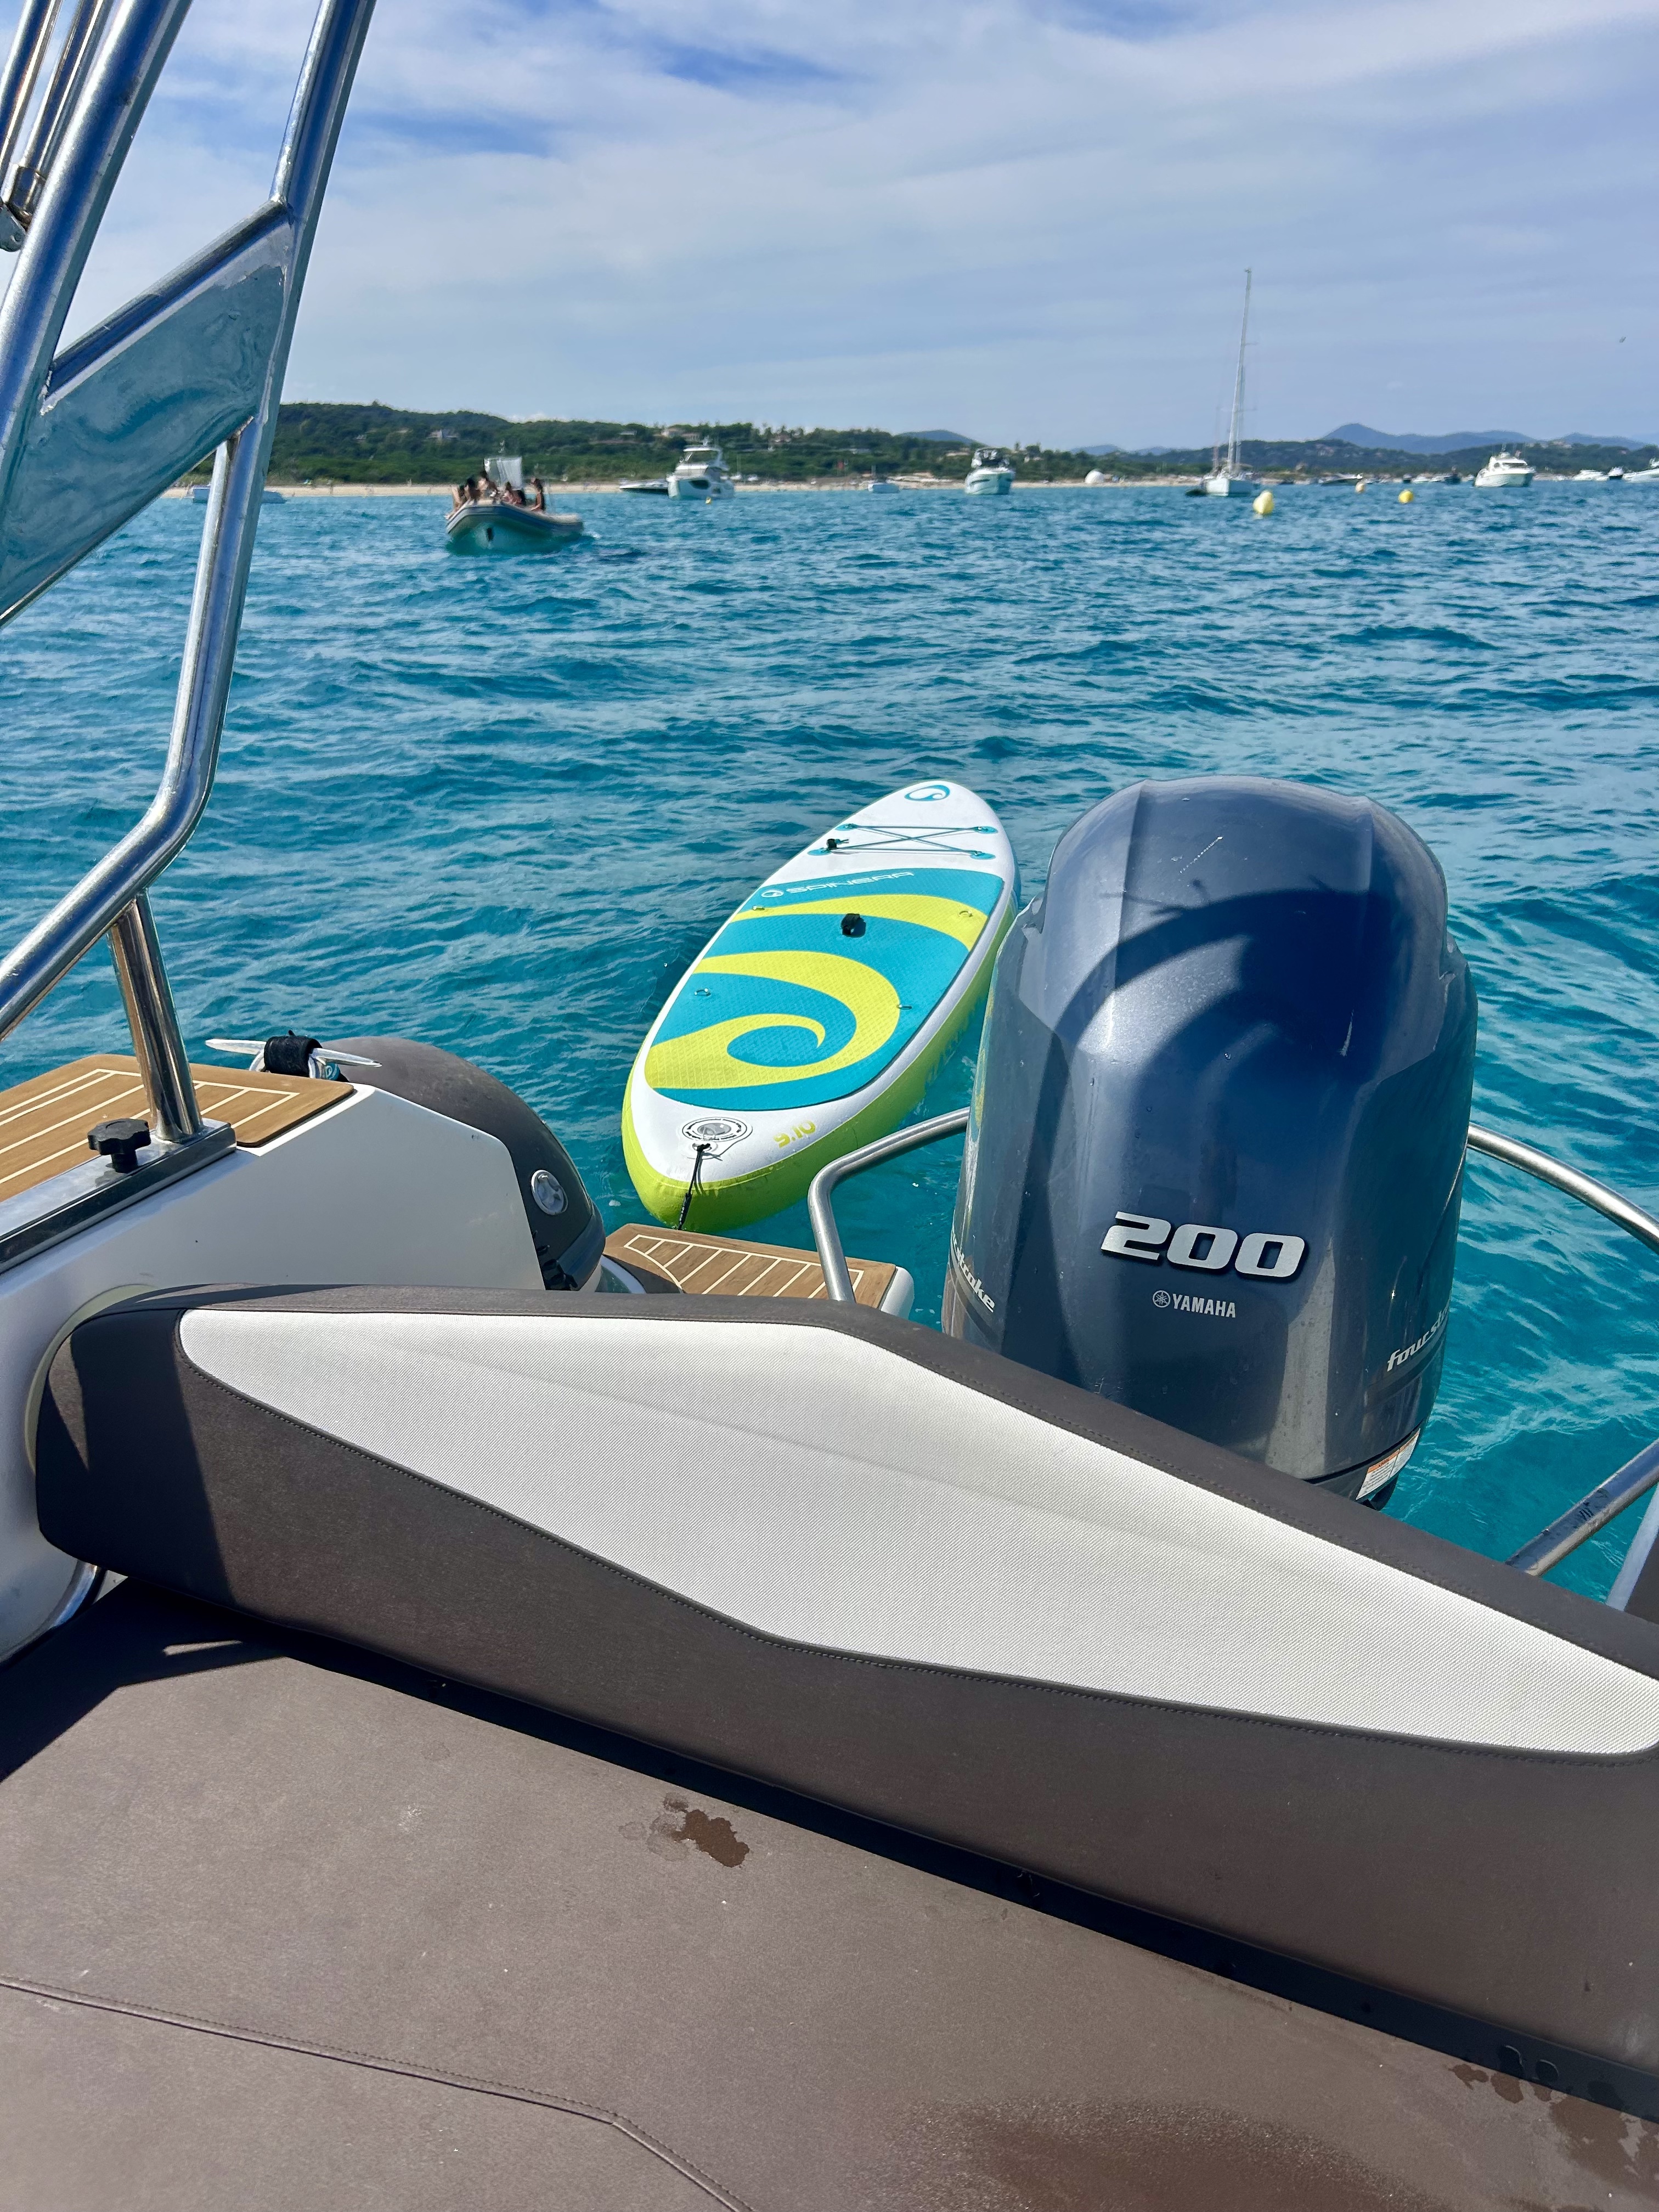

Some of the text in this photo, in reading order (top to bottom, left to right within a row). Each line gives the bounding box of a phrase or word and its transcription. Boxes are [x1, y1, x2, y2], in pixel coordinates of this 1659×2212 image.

[786, 872, 915, 894] SPINERA
[1101, 1211, 1306, 1278] 200
[1172, 1293, 1236, 1318] YAMAHA
